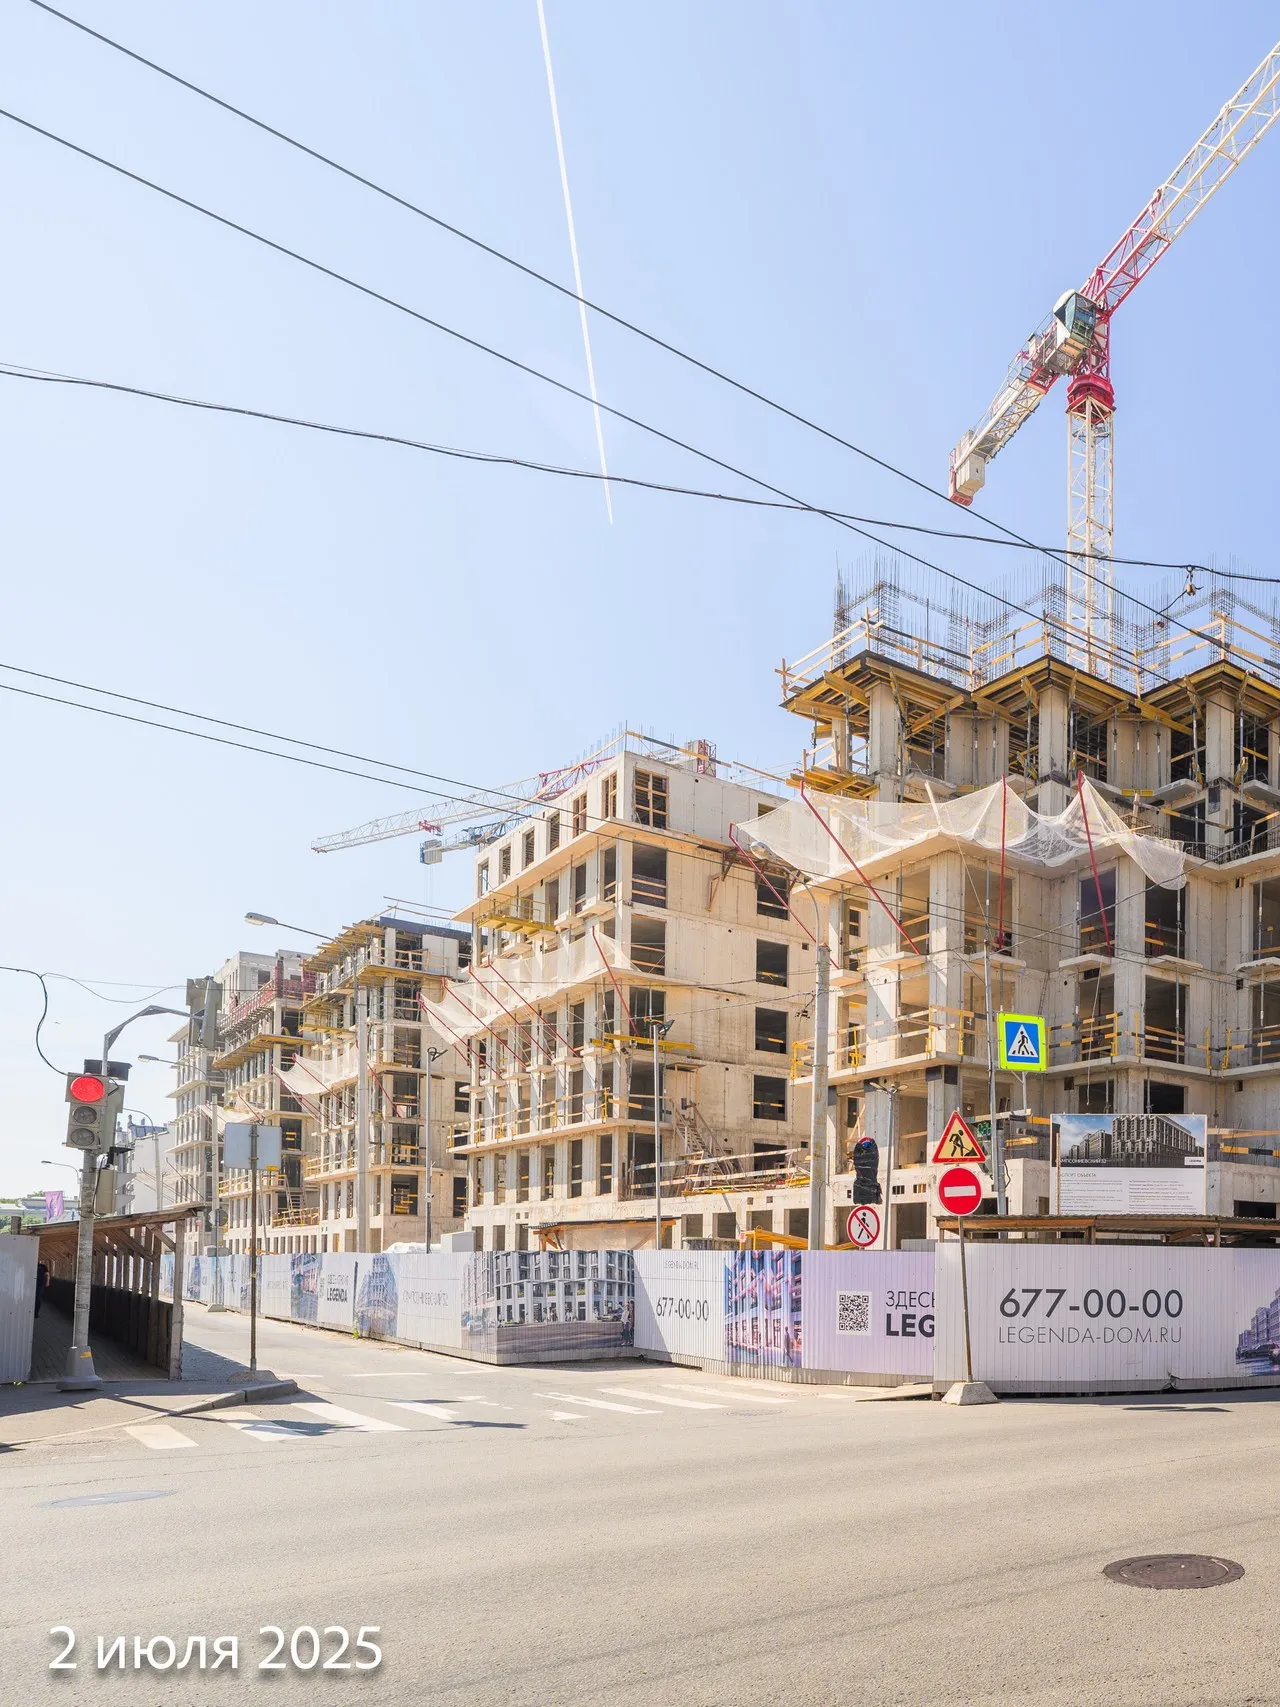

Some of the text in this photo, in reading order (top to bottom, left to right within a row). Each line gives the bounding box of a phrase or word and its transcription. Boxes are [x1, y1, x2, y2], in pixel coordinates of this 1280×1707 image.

[656, 1297, 710, 1322] 677-00-00
[999, 1287, 1183, 1318] 677-00-00
[999, 1326, 1182, 1344] LEGENDA-DOM.RU
